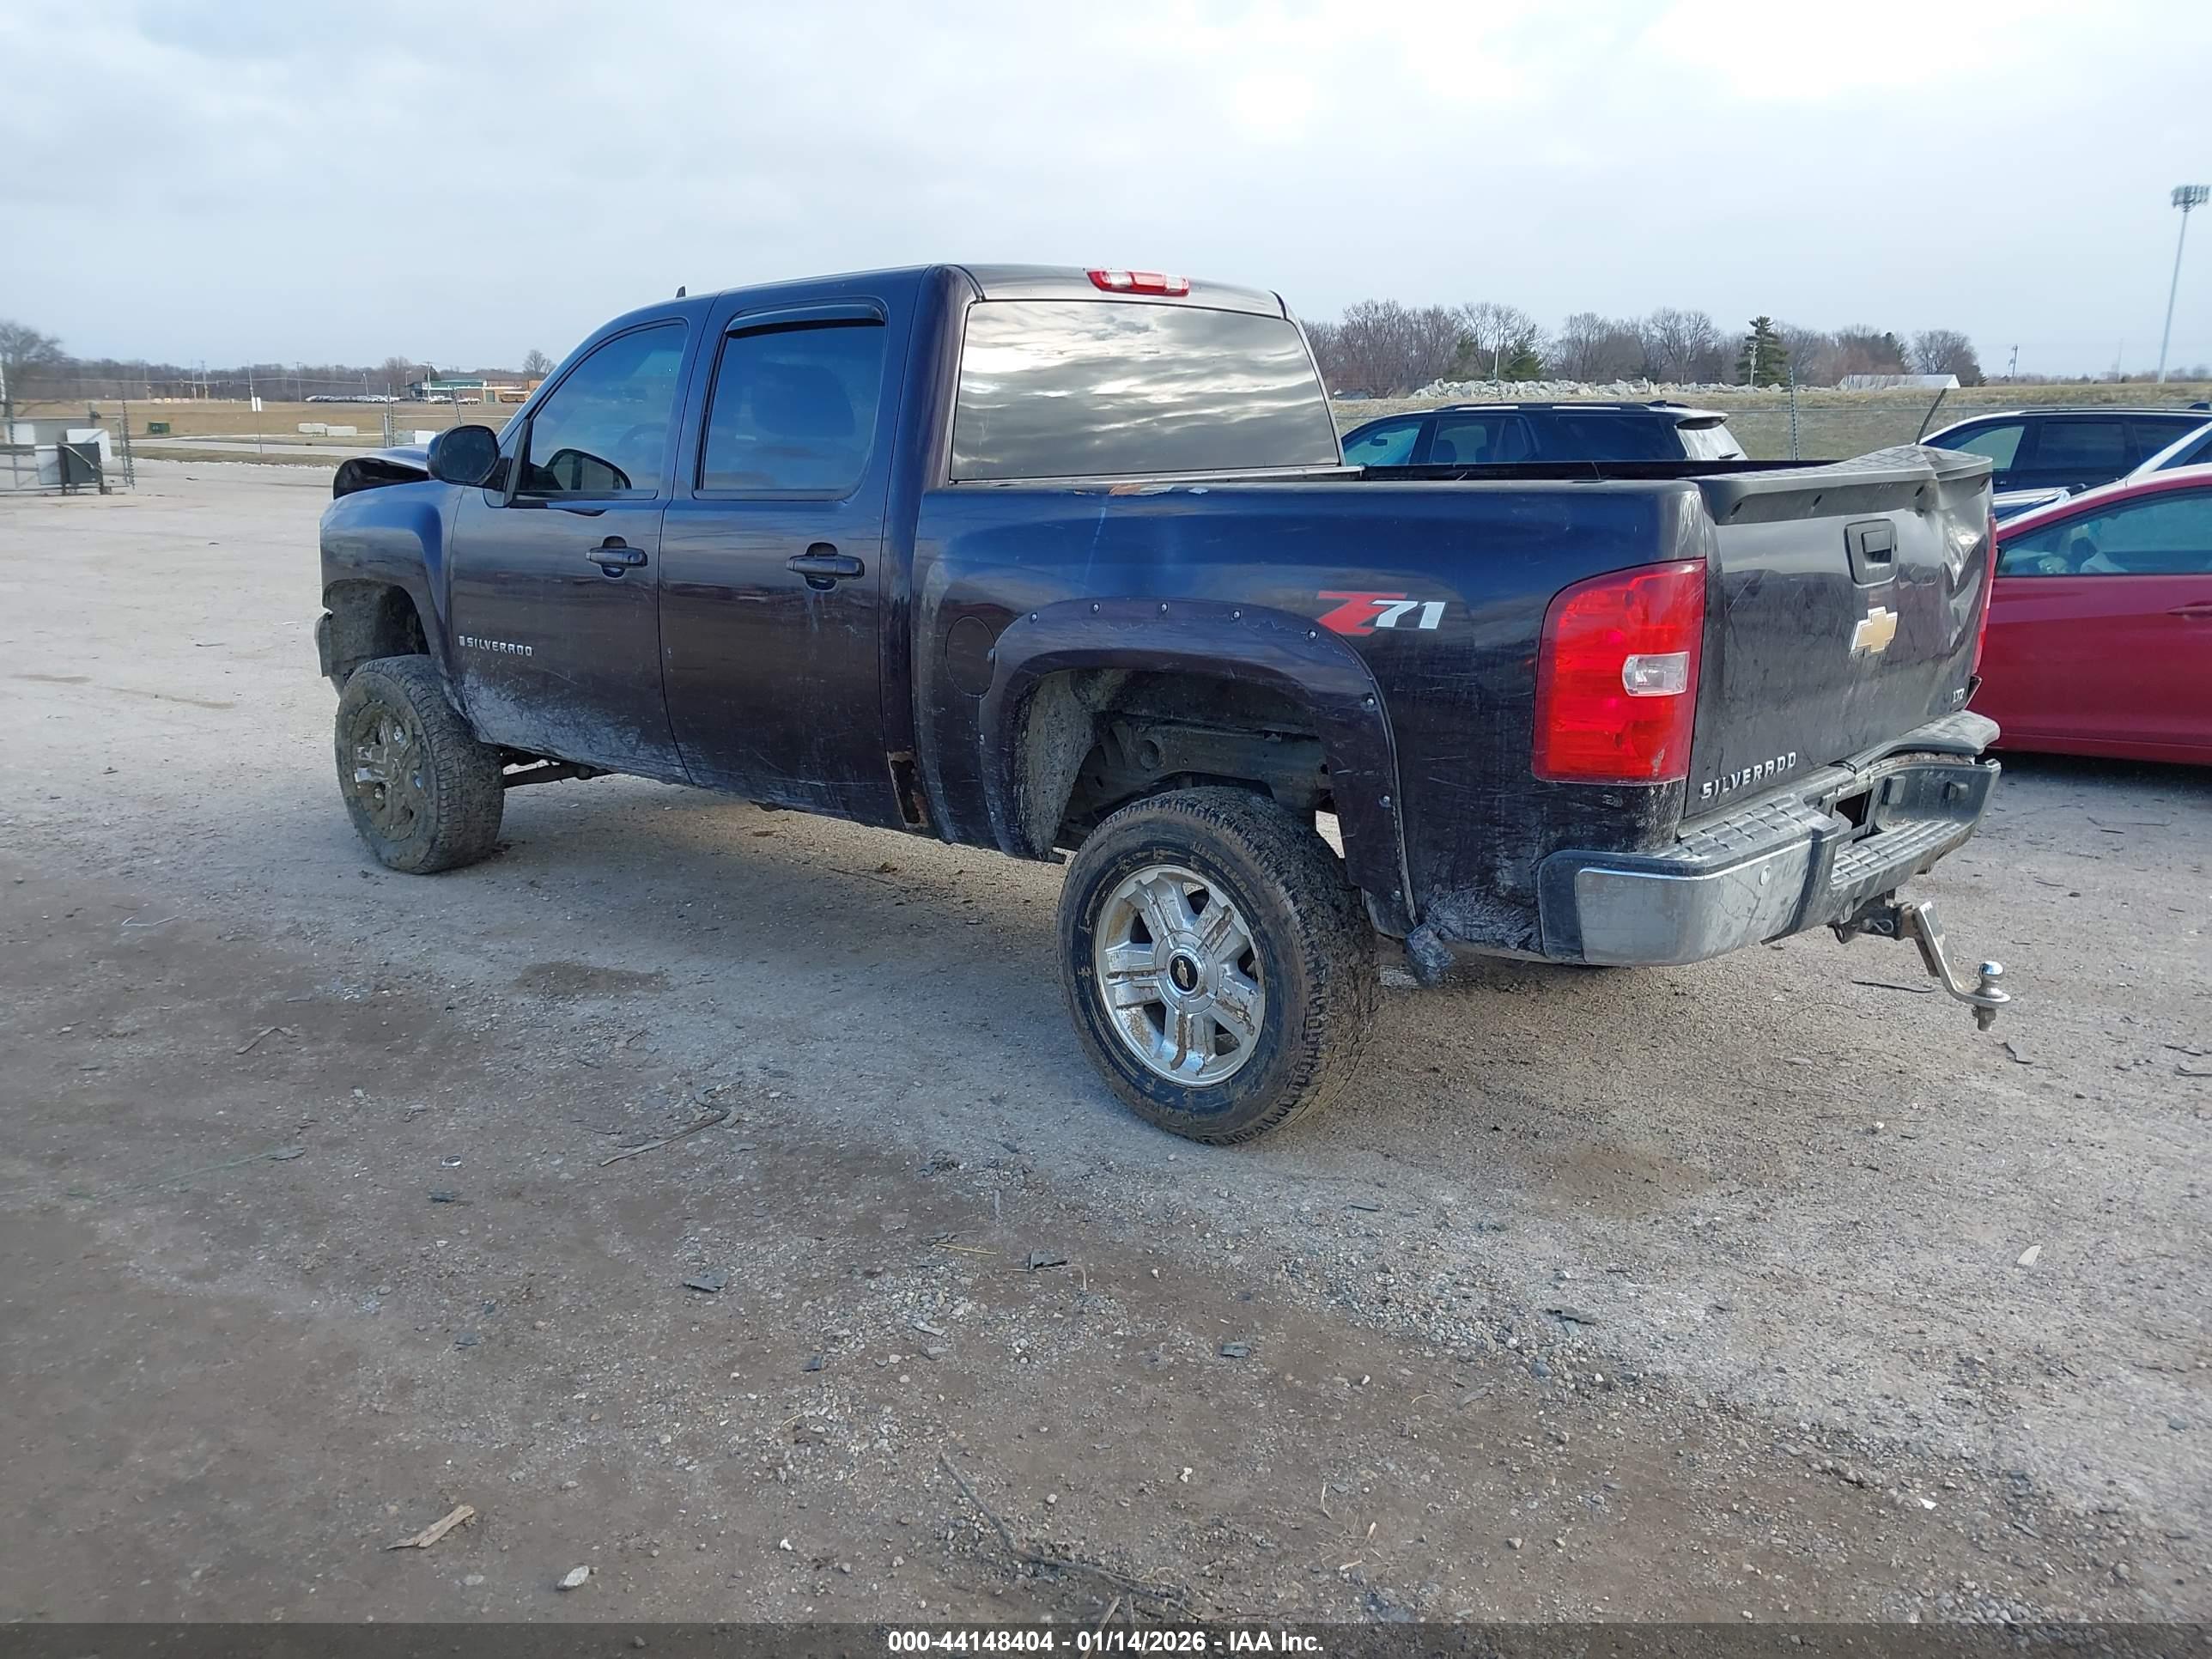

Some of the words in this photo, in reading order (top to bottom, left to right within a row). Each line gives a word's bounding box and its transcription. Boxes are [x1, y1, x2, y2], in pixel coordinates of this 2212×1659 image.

[1316, 590, 1447, 636] Z71
[466, 636, 533, 657] SILVERADO
[1701, 751, 1797, 800] SILVERADO
